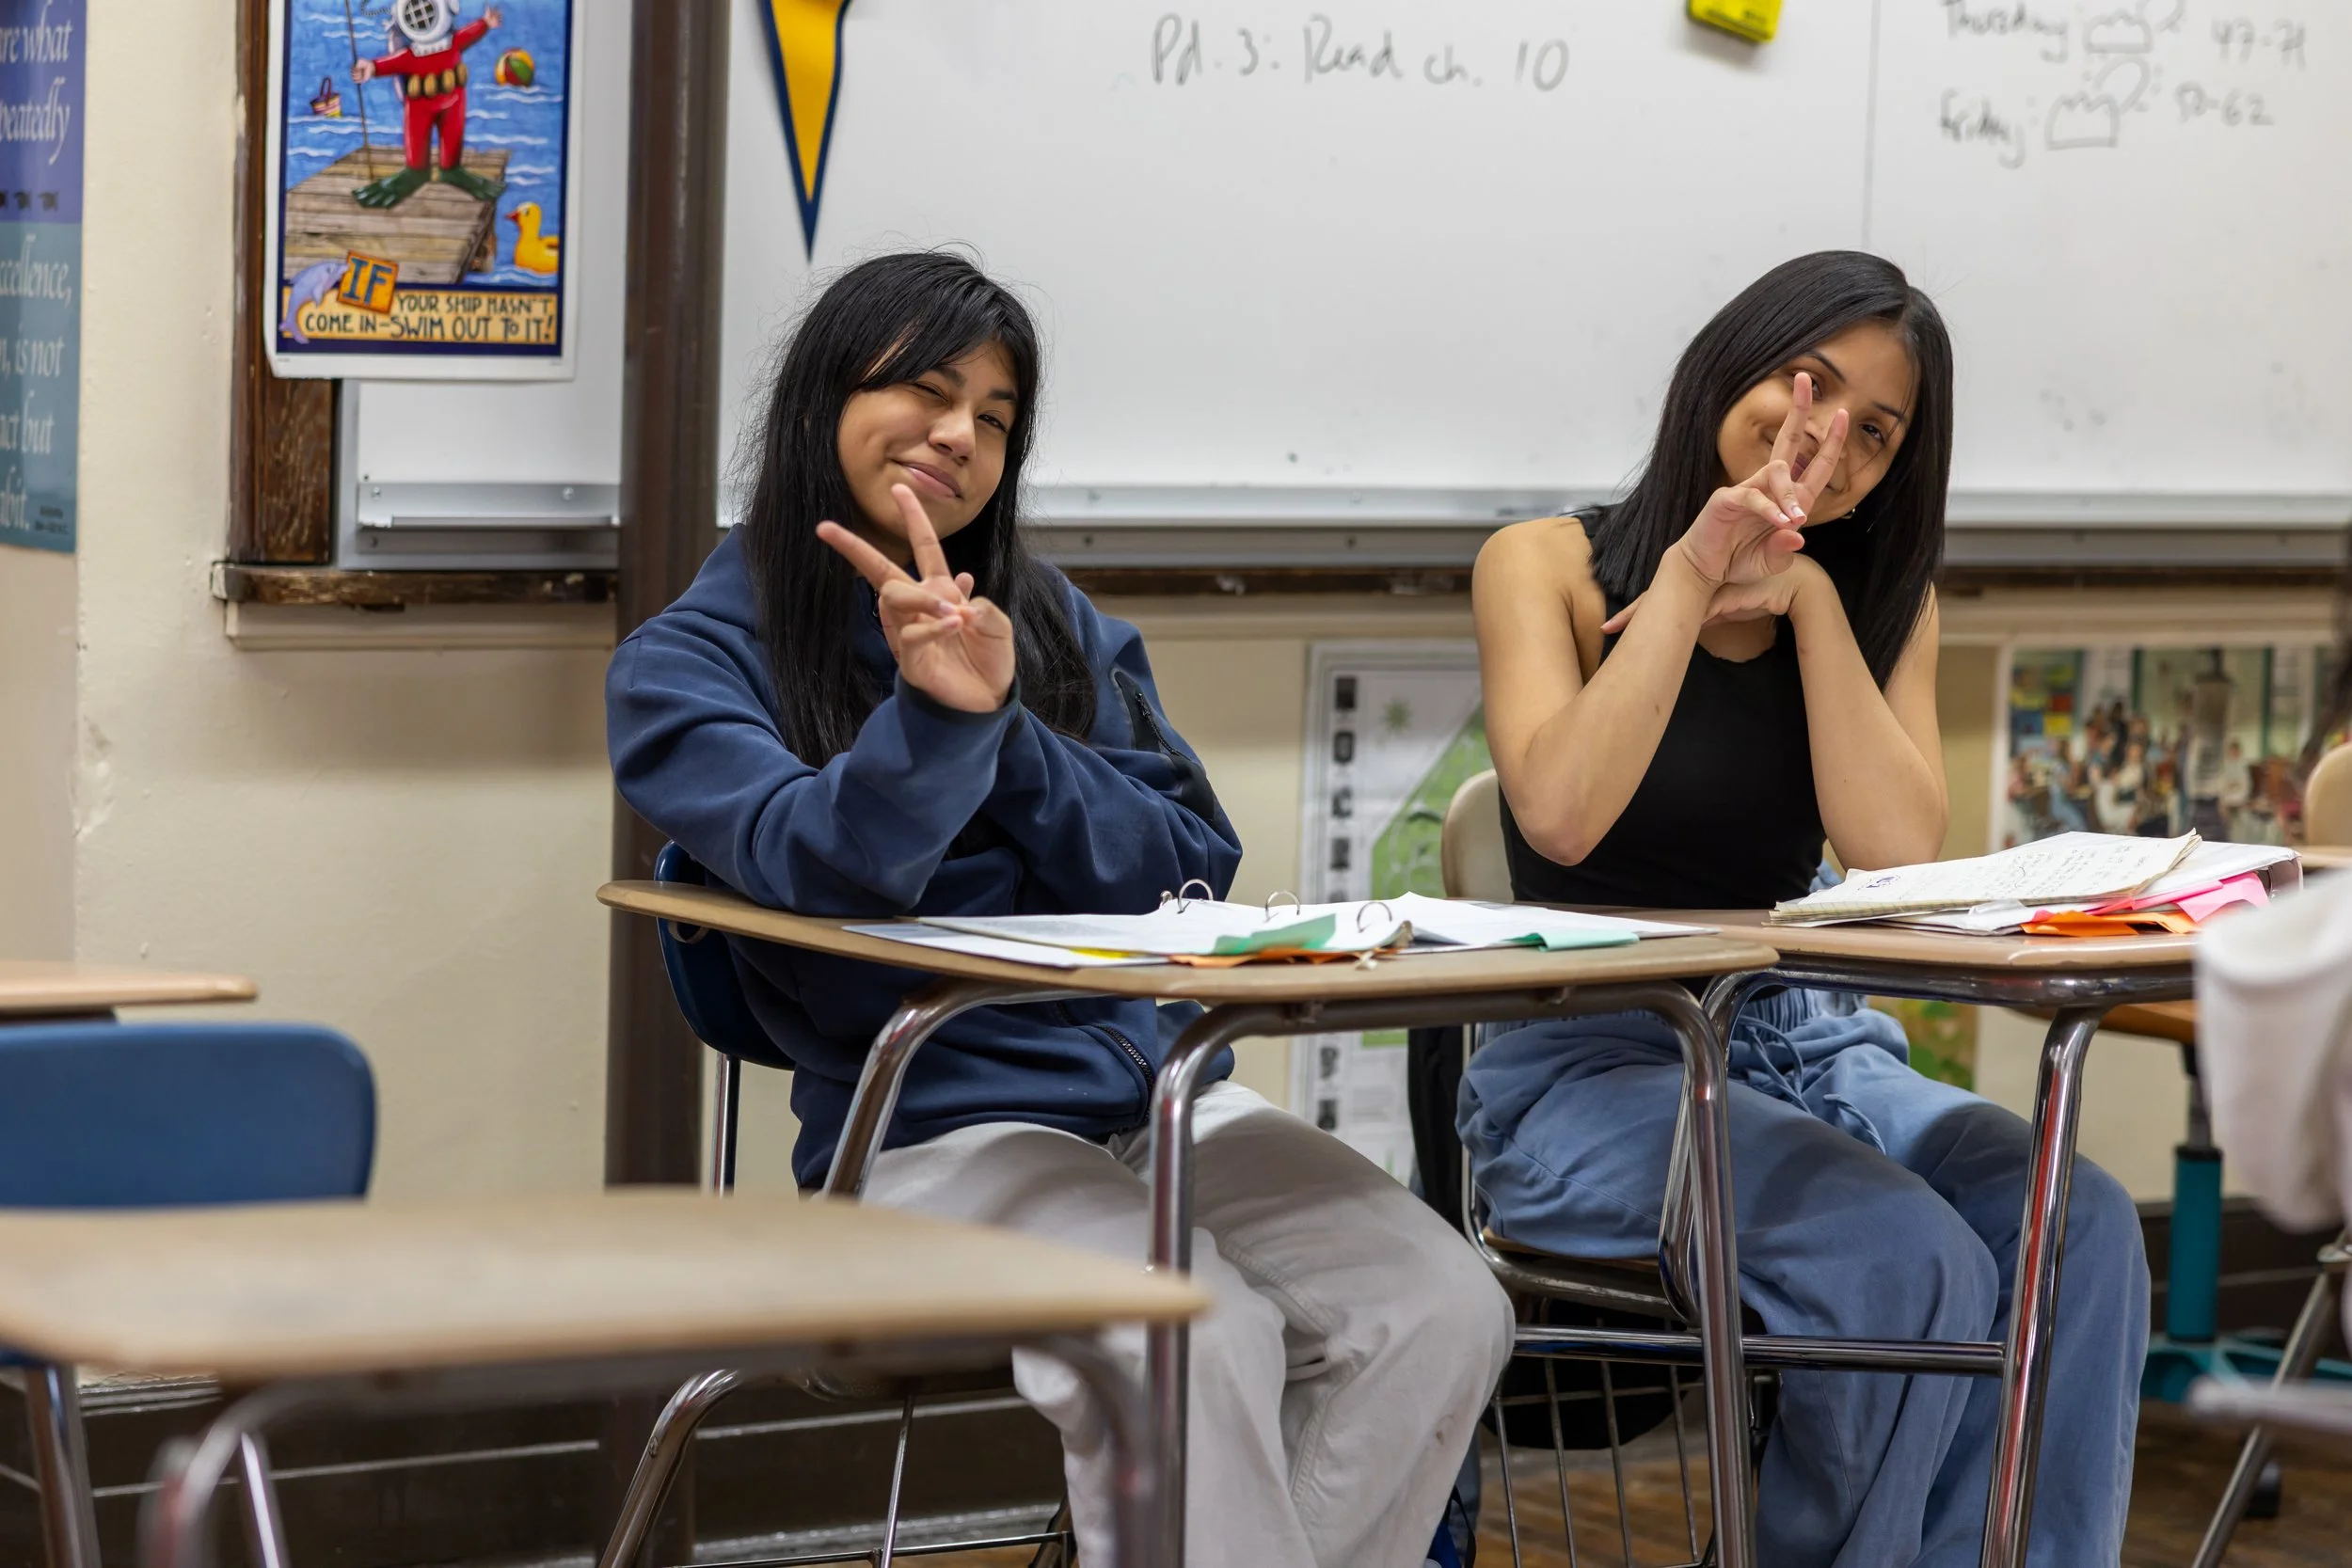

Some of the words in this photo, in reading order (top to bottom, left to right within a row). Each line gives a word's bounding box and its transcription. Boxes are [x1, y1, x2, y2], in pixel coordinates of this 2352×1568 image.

[0, 26, 20, 63] re
[23, 0, 73, 63] what
[1235, 26, 1280, 77] 3:
[1302, 12, 1405, 85] Read
[1515, 39, 1570, 92] 10
[342, 257, 392, 306] IF
[396, 293, 439, 313] YOUR
[446, 295, 484, 314] SHIP
[487, 298, 553, 316] HASN'T
[15, 322, 29, 374] is
[31, 336, 66, 378] not
[305, 312, 355, 334] COME
[453, 316, 491, 341] OUT
[526, 314, 555, 342] IT!
[22, 388, 55, 455] but
